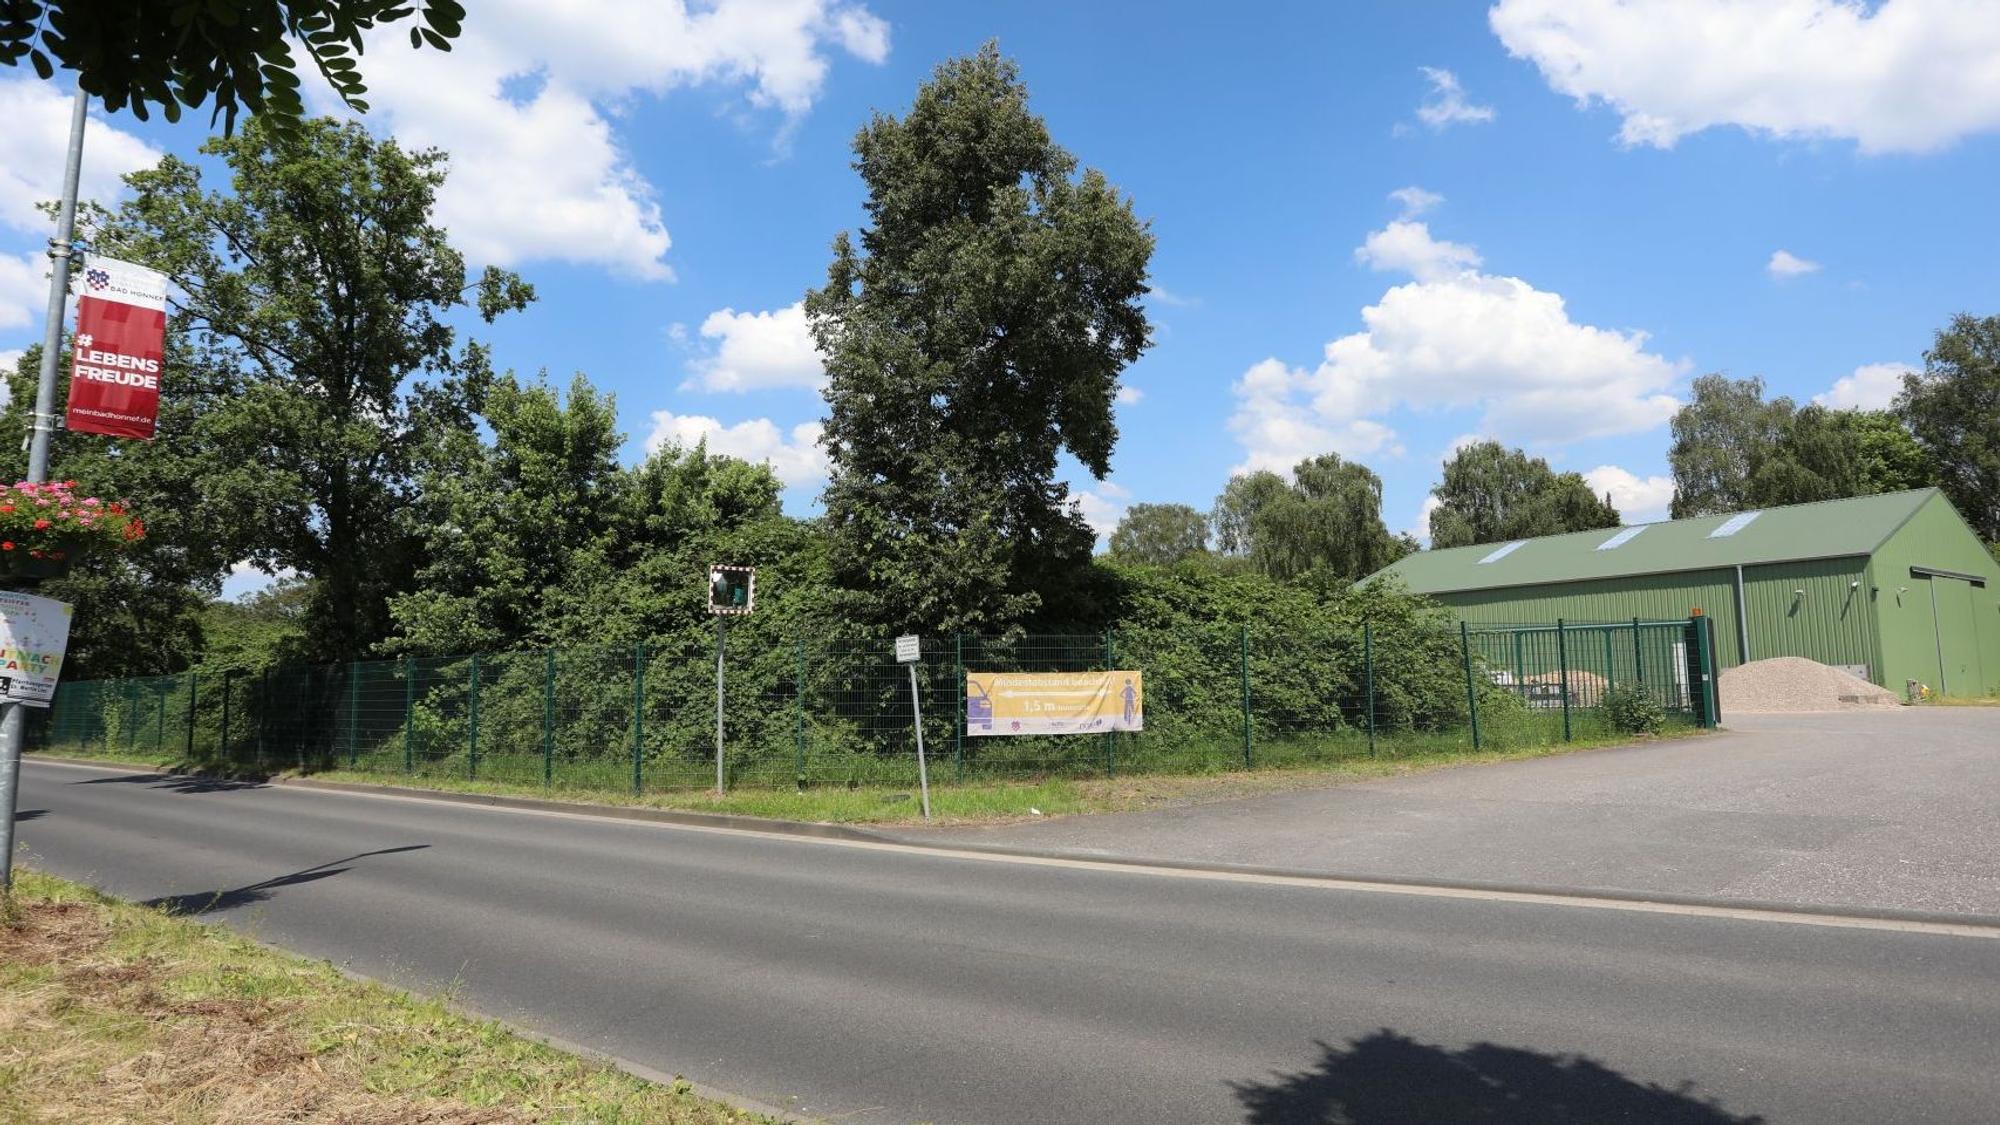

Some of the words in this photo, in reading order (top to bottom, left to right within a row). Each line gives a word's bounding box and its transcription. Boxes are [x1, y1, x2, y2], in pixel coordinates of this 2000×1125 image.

[110, 286, 128, 295] BAD
[130, 290, 164, 301] HONNEF
[76, 348, 159, 373] LEBENS
[75, 364, 157, 389] FREUDE
[72, 408, 152, 424] meinbadhonnef.de
[1024, 700, 1041, 713] 1,5
[1044, 702, 1056, 711] m
